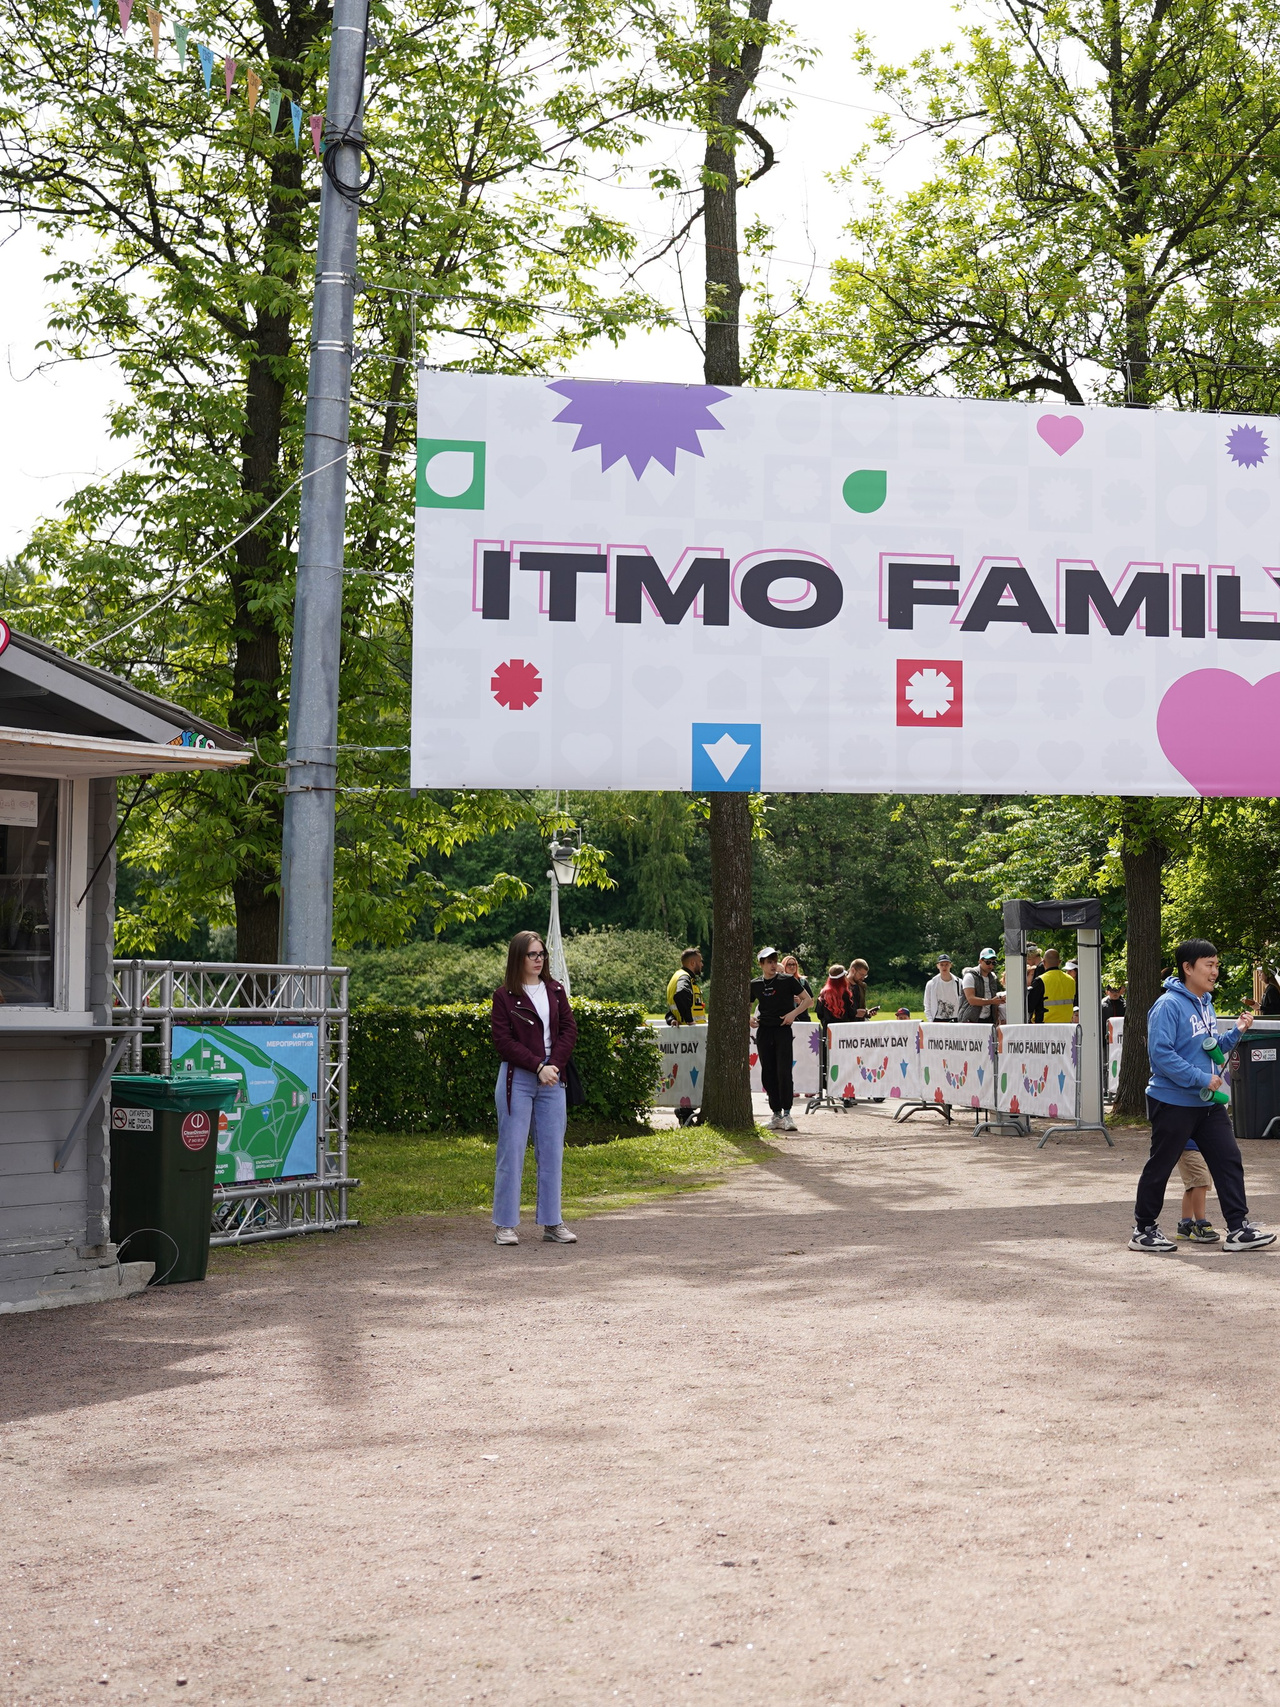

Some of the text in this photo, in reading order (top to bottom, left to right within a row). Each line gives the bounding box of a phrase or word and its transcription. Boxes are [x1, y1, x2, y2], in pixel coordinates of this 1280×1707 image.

[474, 541, 845, 630] ITMO
[681, 1042, 699, 1054] DAY
[838, 1036, 909, 1049] ITMO FAMILY DAY
[928, 1039, 983, 1052] ITMO FAMILY DAY
[1007, 1042, 1066, 1055] ITMO FAMILY DAY
[129, 1109, 152, 1118] СИГАРЕТЫ
[128, 1118, 136, 1129] НЕ
